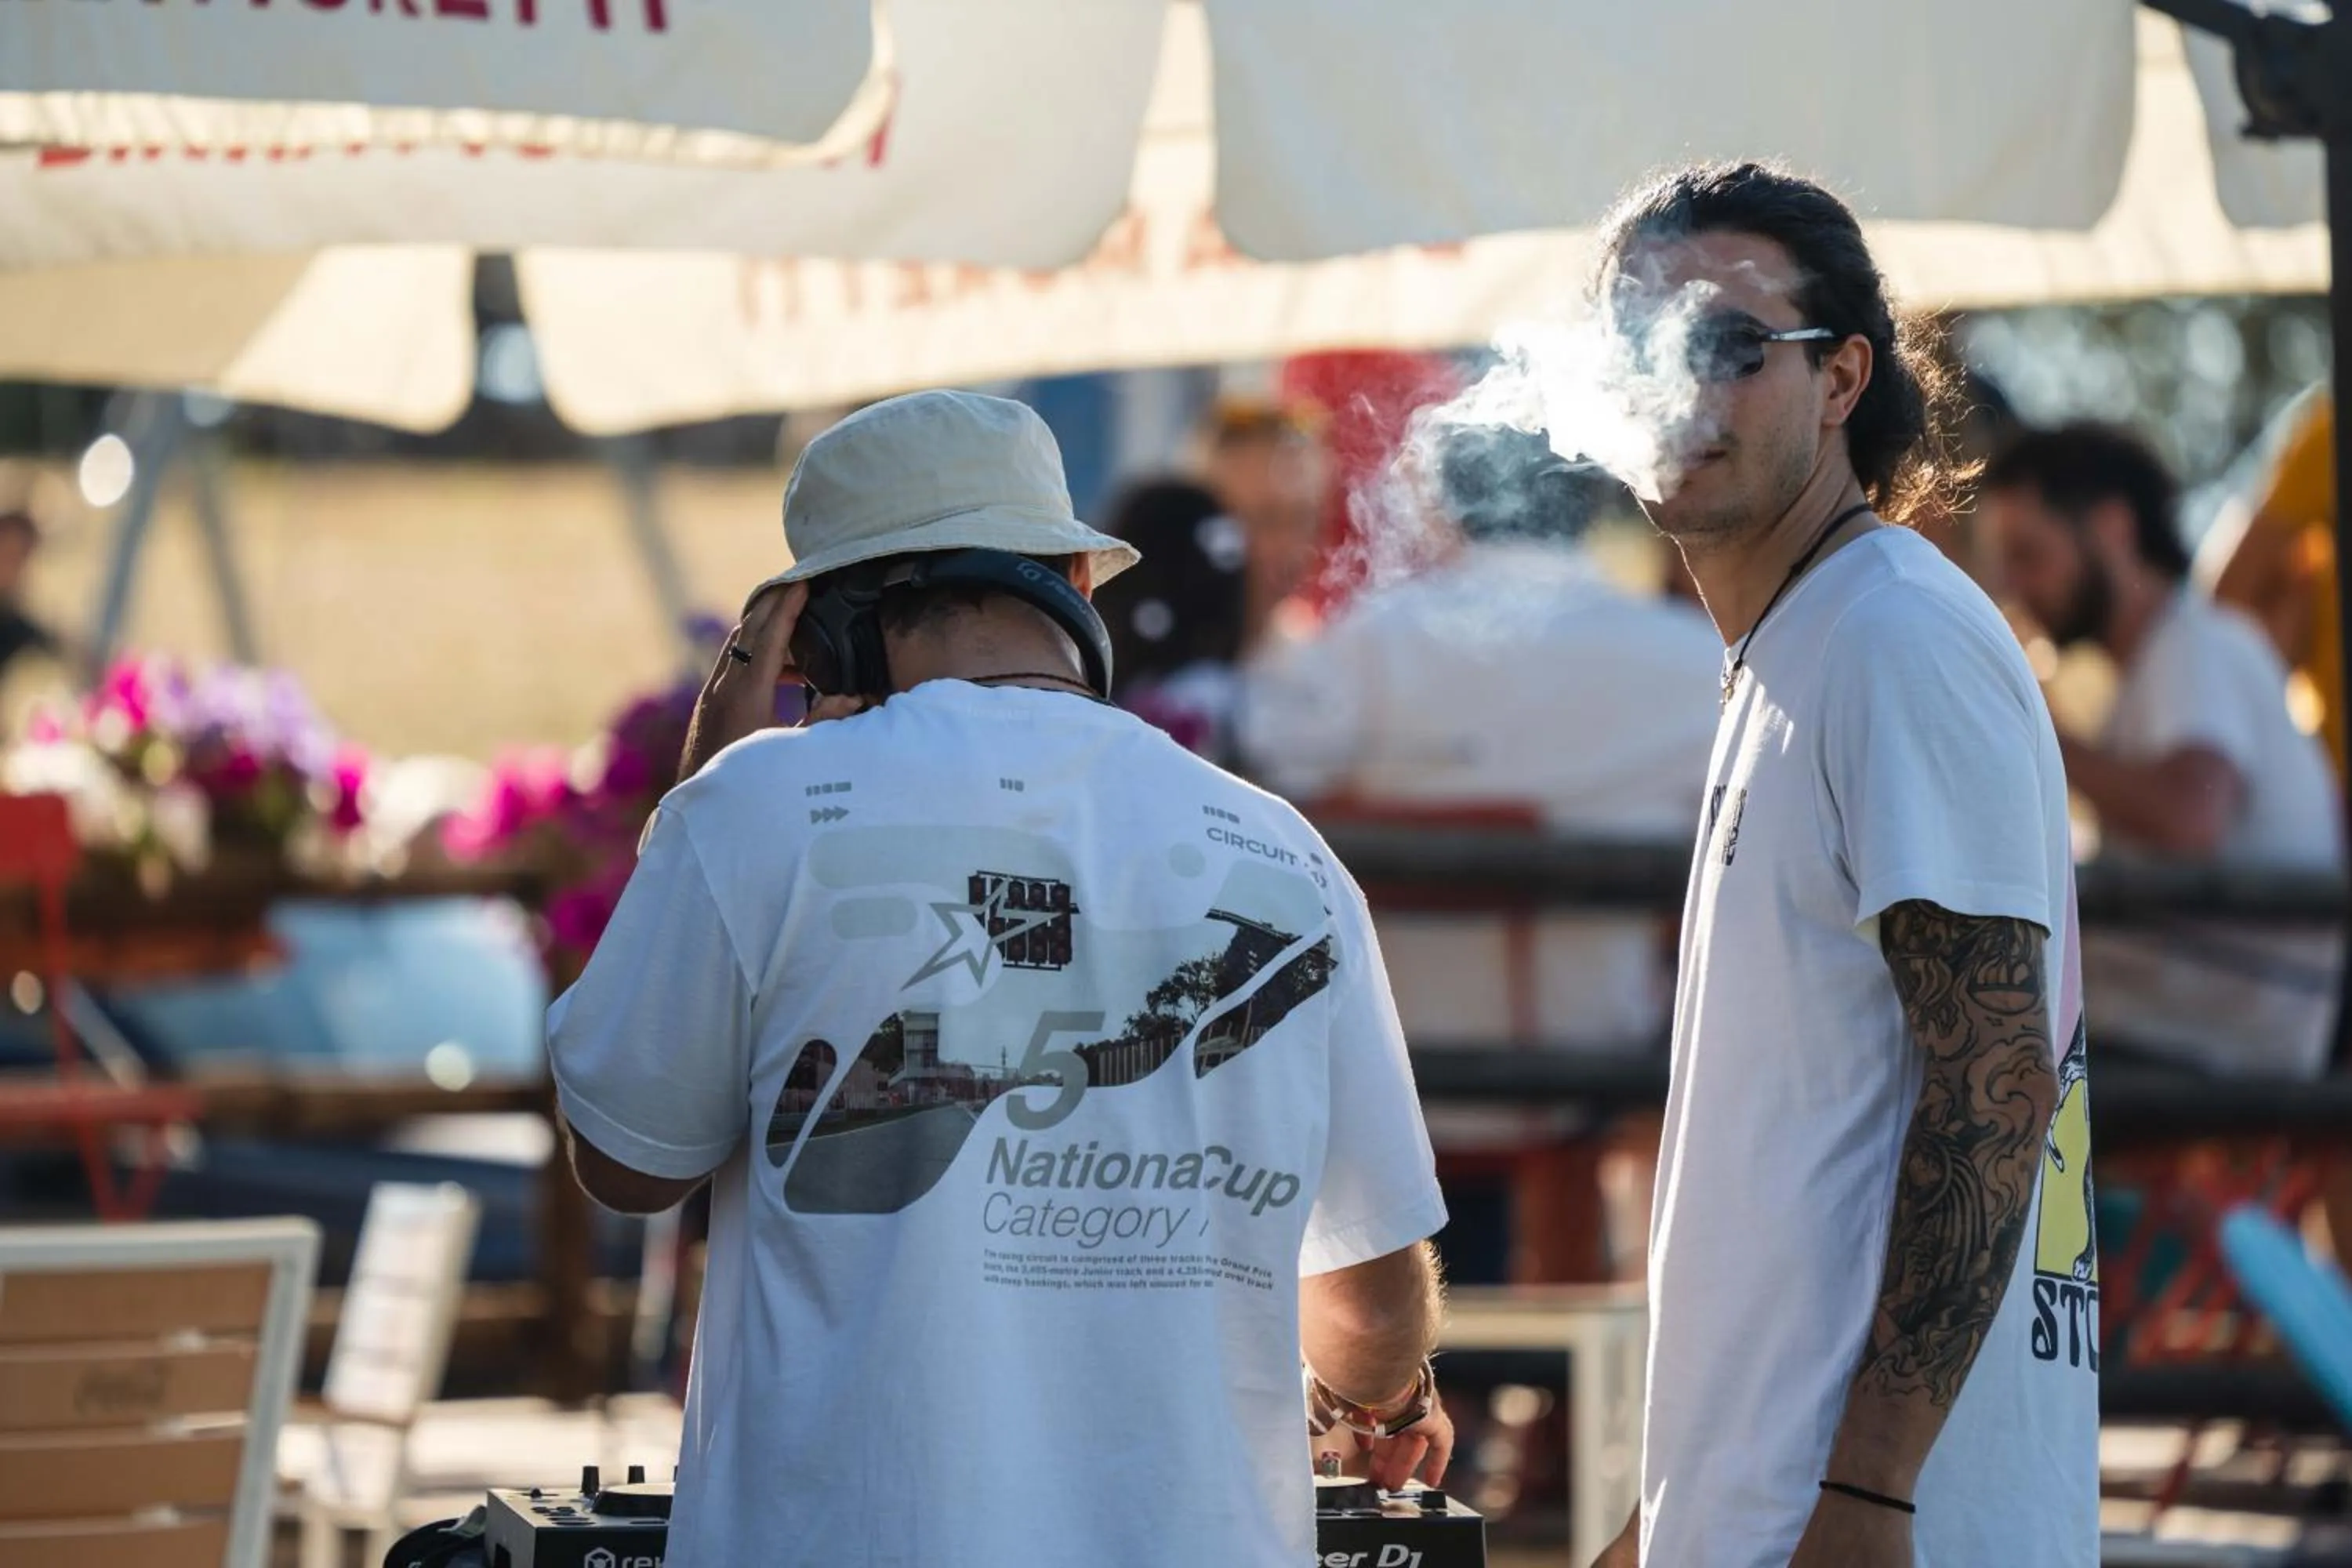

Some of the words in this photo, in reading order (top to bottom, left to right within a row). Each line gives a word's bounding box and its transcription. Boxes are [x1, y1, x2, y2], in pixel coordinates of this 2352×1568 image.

[1206, 826, 1298, 866] CIRCUIT
[1006, 1011, 1105, 1131] 5
[982, 1191, 1190, 1249] Category
[1026, 1253, 1058, 1263] circuit
[1072, 1254, 1124, 1265] comprised
[1127, 1254, 1137, 1264] of
[1140, 1254, 1167, 1264] three
[1220, 1258, 1250, 1272] Grand
[1081, 1265, 1113, 1276] Junior
[1116, 1266, 1142, 1276] track
[1145, 1267, 1164, 1276] and
[1247, 1278, 1274, 1291] track
[1074, 1278, 1104, 1289] which
[1130, 1279, 1146, 1290] left
